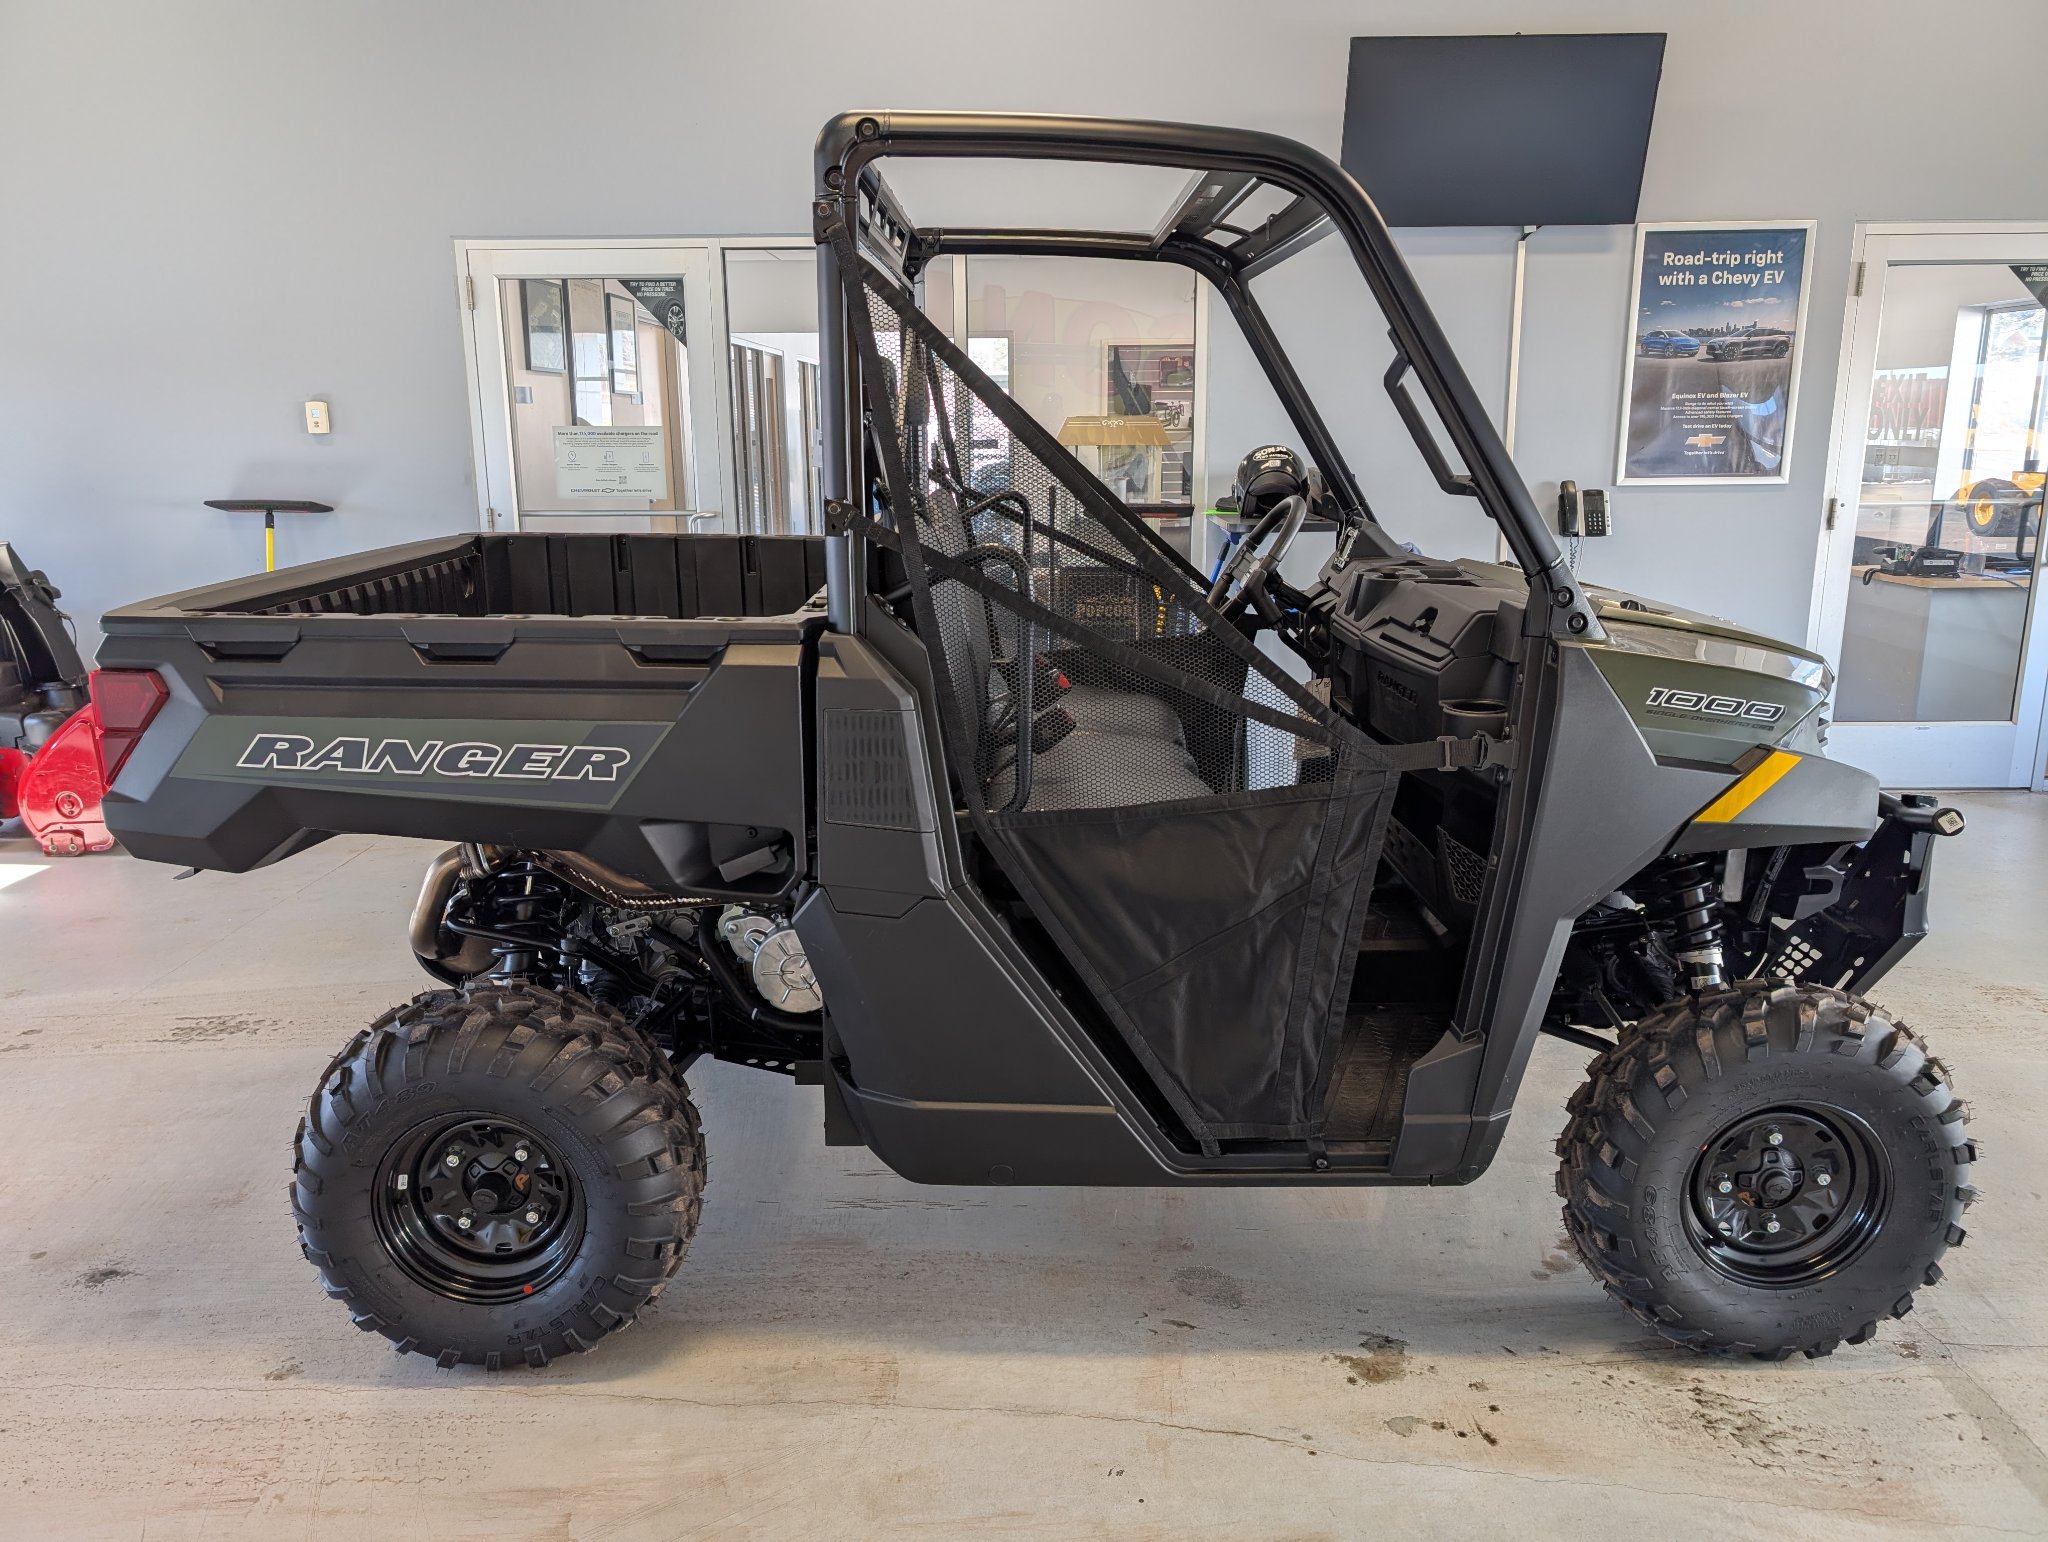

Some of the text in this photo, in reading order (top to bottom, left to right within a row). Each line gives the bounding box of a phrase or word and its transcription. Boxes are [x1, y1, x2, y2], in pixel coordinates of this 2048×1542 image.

[1663, 250, 1784, 268] Road-trip right
[1658, 270, 1785, 288] with a Chevy EV
[1874, 372, 1928, 404] EXIT
[1867, 406, 1929, 441] ONLY
[1255, 446, 1287, 457] SONJU
[1645, 687, 1787, 723] 1000
[1645, 709, 1686, 719] SINGLE
[1690, 714, 1750, 729] OVERHEAD
[235, 733, 631, 782] RANGER
